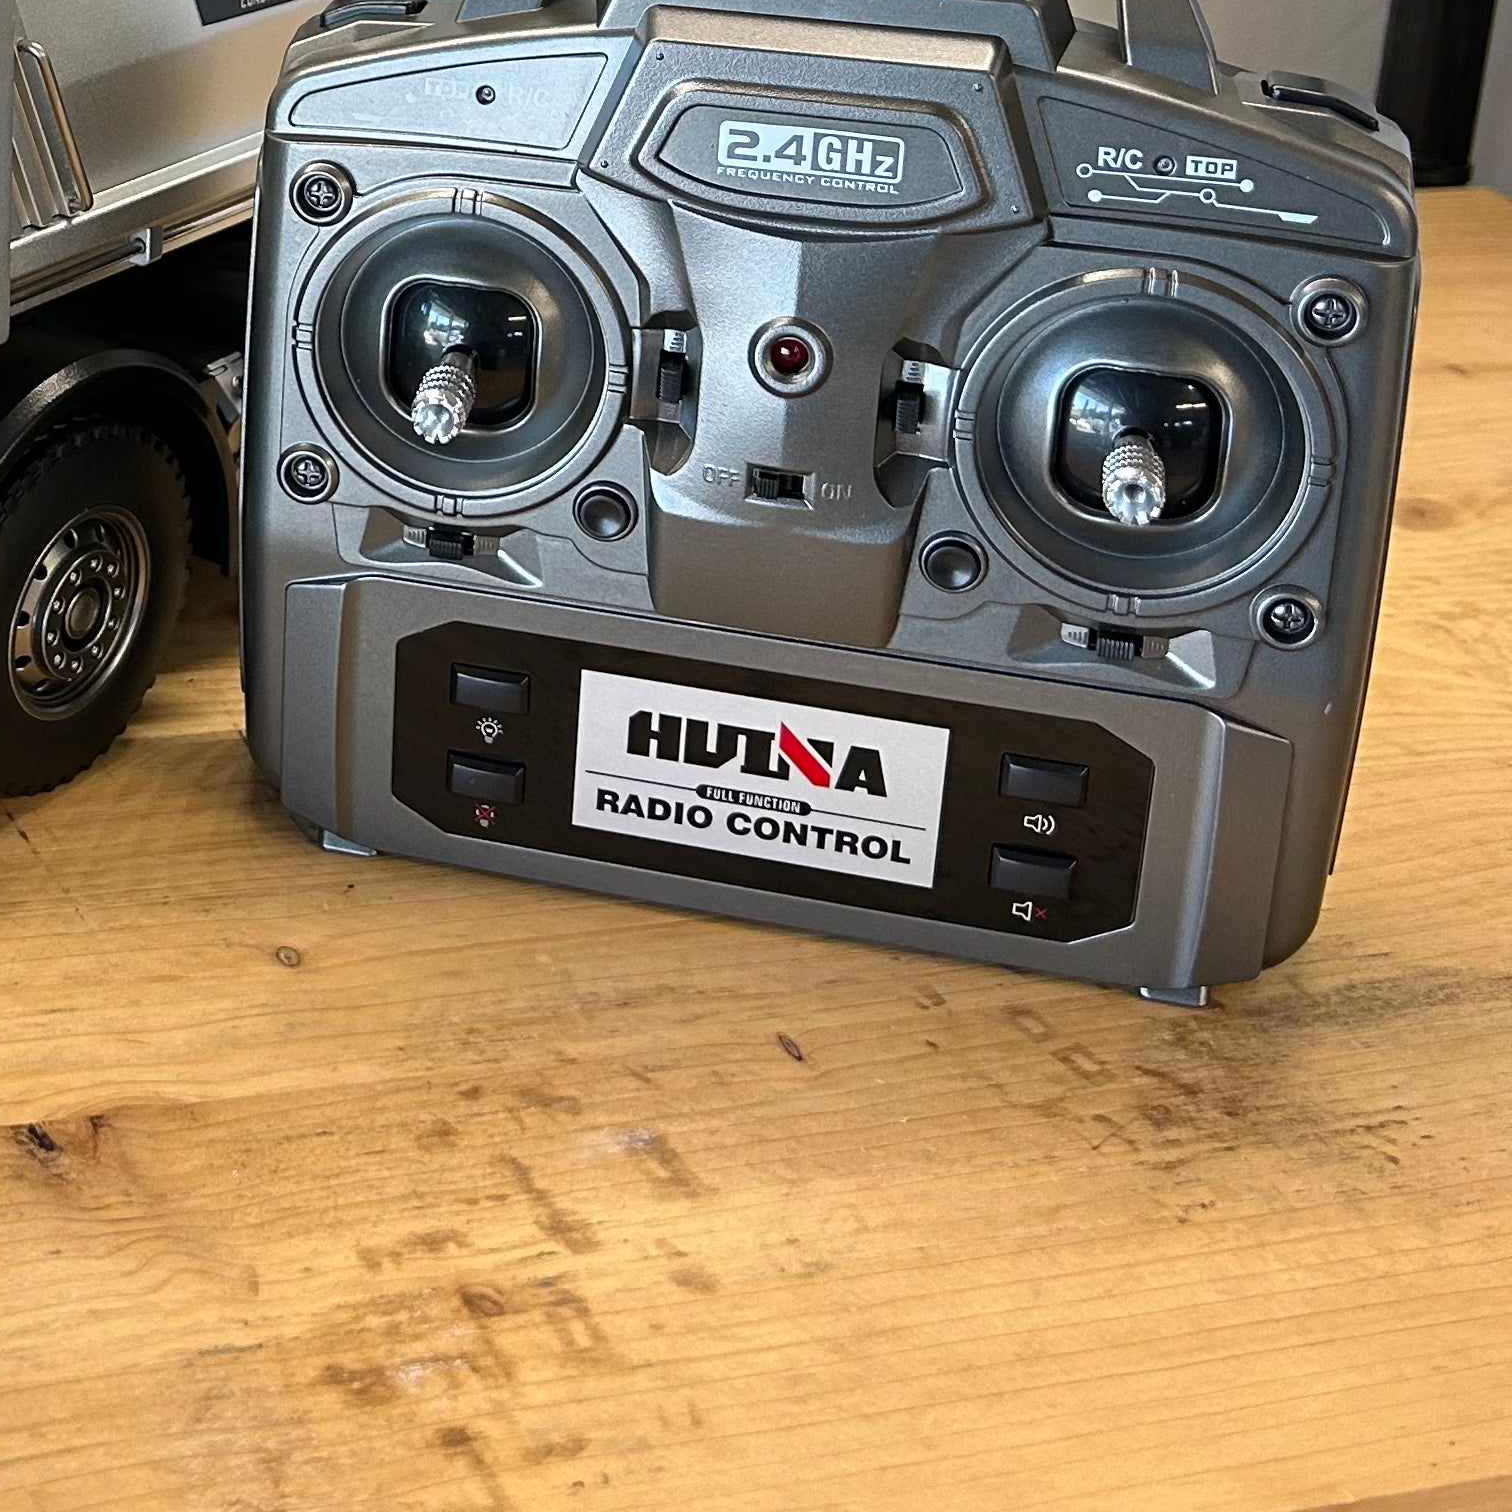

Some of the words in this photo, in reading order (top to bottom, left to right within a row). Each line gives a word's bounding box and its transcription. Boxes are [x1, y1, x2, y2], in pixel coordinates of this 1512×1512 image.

[1097, 146, 1144, 170] R/C
[1190, 159, 1234, 176] TOP
[716, 166, 815, 185] FREQUENCY
[820, 177, 900, 195] CONTROL
[702, 463, 740, 487] OFF
[821, 481, 852, 500] ON
[706, 787, 735, 804] FULL
[738, 794, 801, 814] FUNCTION
[596, 788, 714, 829] RADIO
[726, 811, 912, 865] CONTROL
